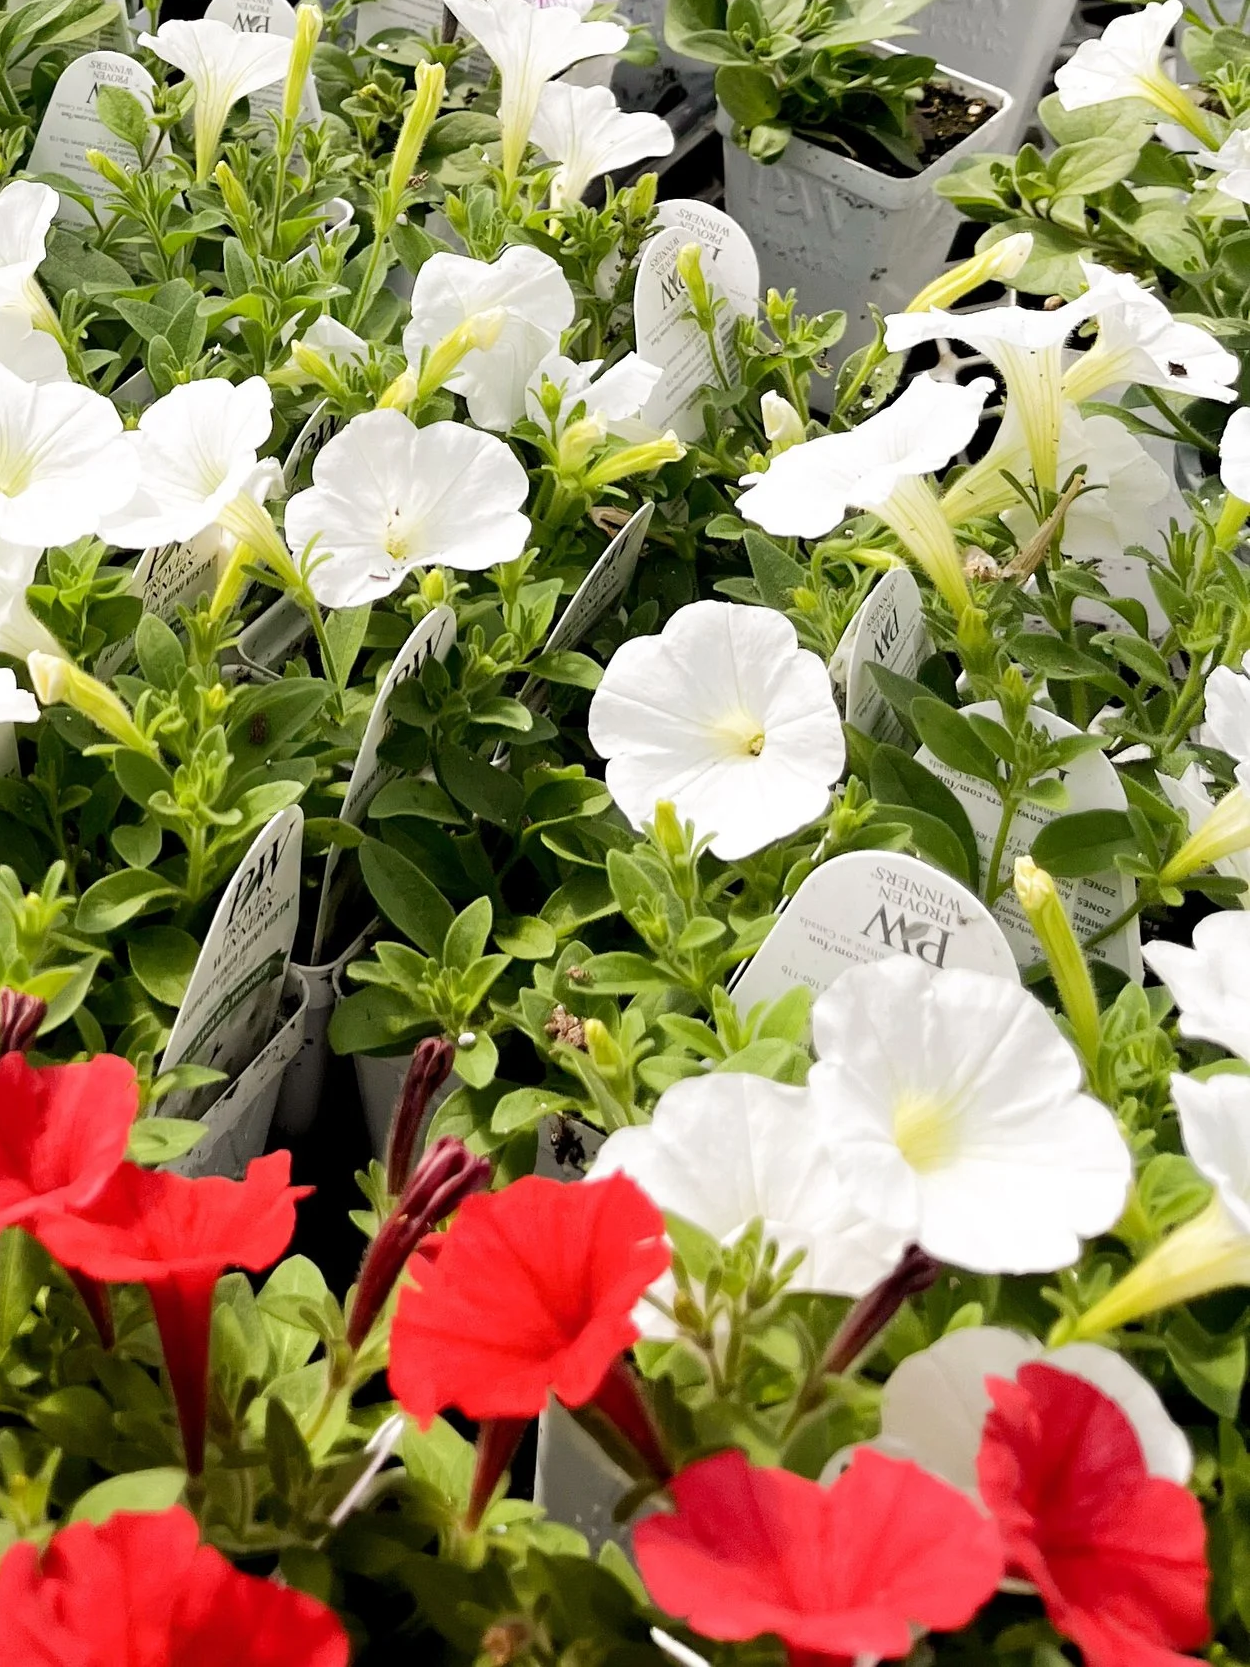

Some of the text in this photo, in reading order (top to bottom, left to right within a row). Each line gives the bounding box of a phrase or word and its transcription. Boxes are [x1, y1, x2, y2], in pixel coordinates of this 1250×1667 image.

[225, 818, 297, 932] PW
[874, 865, 962, 915] WINNERS
[1082, 876, 1117, 898] ZONES
[878, 885, 952, 927] PROVEN
[1077, 895, 1111, 918] ZONES
[859, 902, 956, 970] PW
